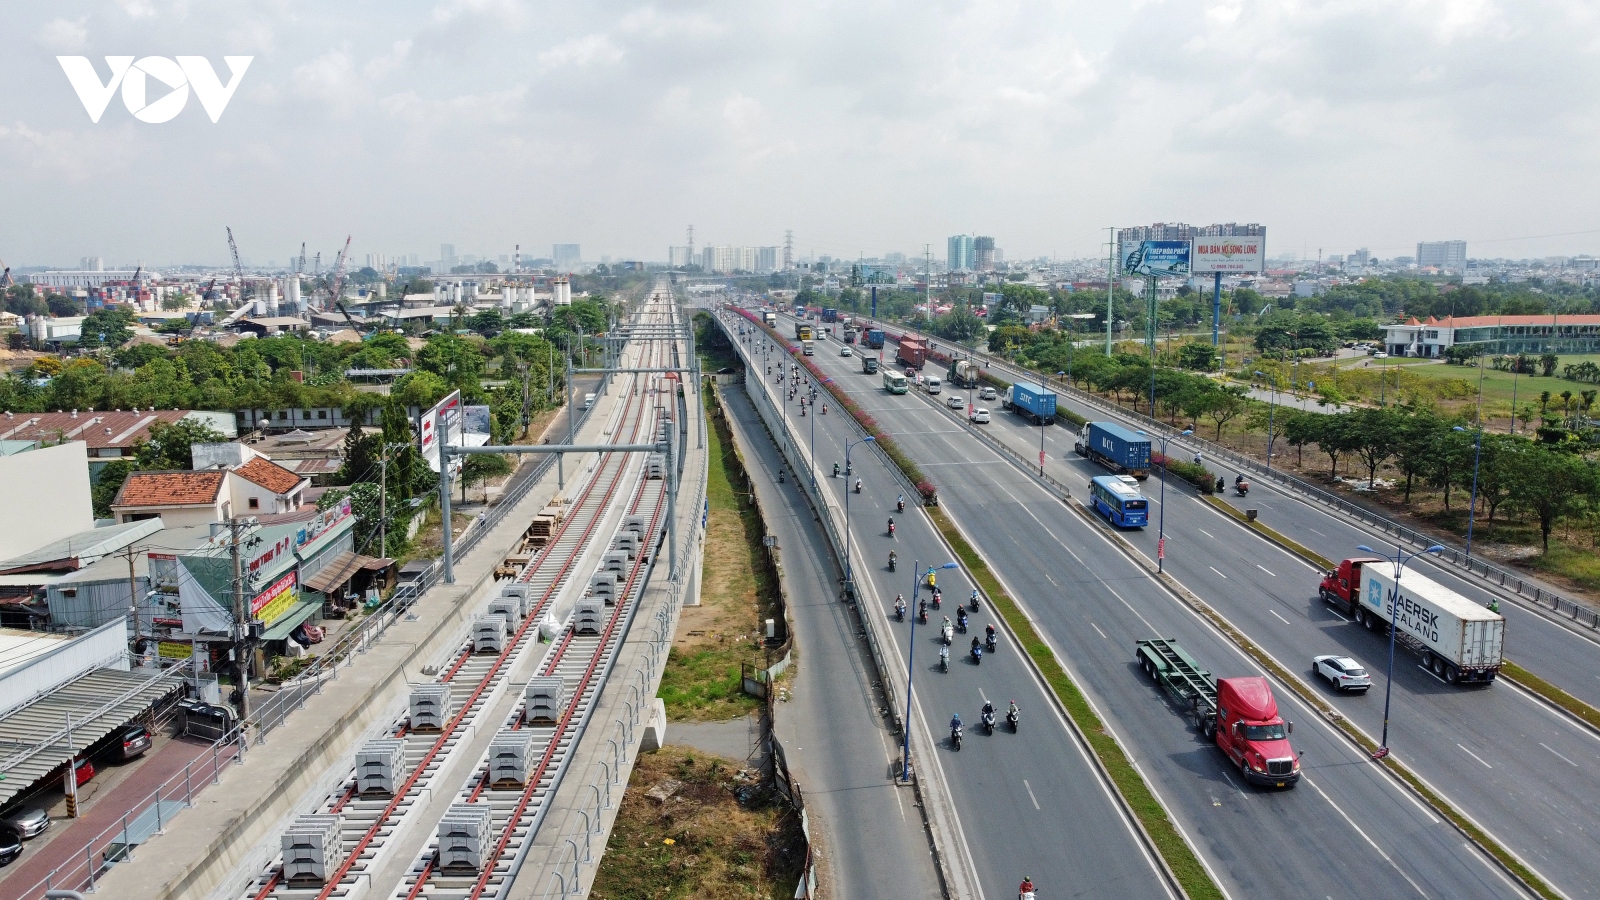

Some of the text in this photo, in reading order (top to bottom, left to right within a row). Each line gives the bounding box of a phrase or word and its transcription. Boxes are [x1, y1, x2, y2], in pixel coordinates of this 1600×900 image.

[1198, 246, 1208, 254] MUA
[1387, 604, 1438, 642] SEALAND
[1388, 588, 1438, 629] MAERSK
